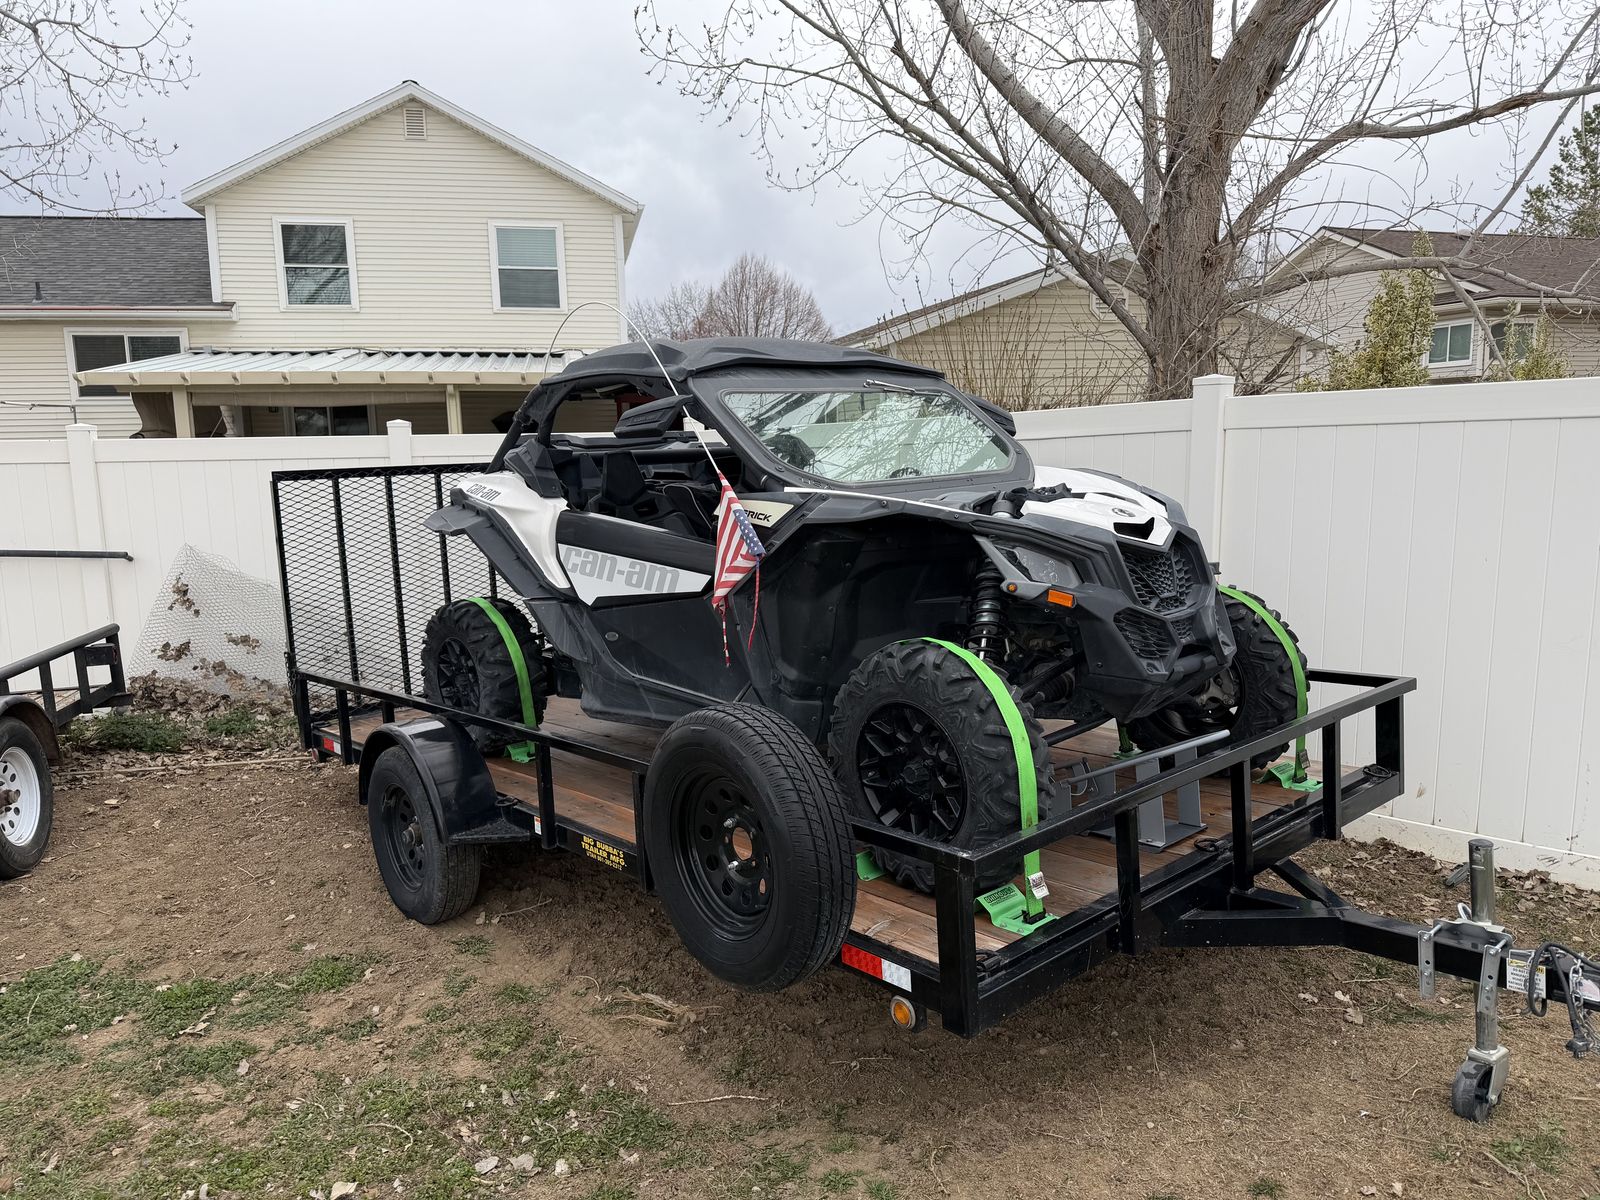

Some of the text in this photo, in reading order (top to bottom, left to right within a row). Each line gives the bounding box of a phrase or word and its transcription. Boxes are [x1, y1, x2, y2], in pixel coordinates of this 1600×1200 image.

[562, 547, 680, 593] can-am
[583, 836, 594, 845] BIG
[581, 842, 608, 858] TRAILER
